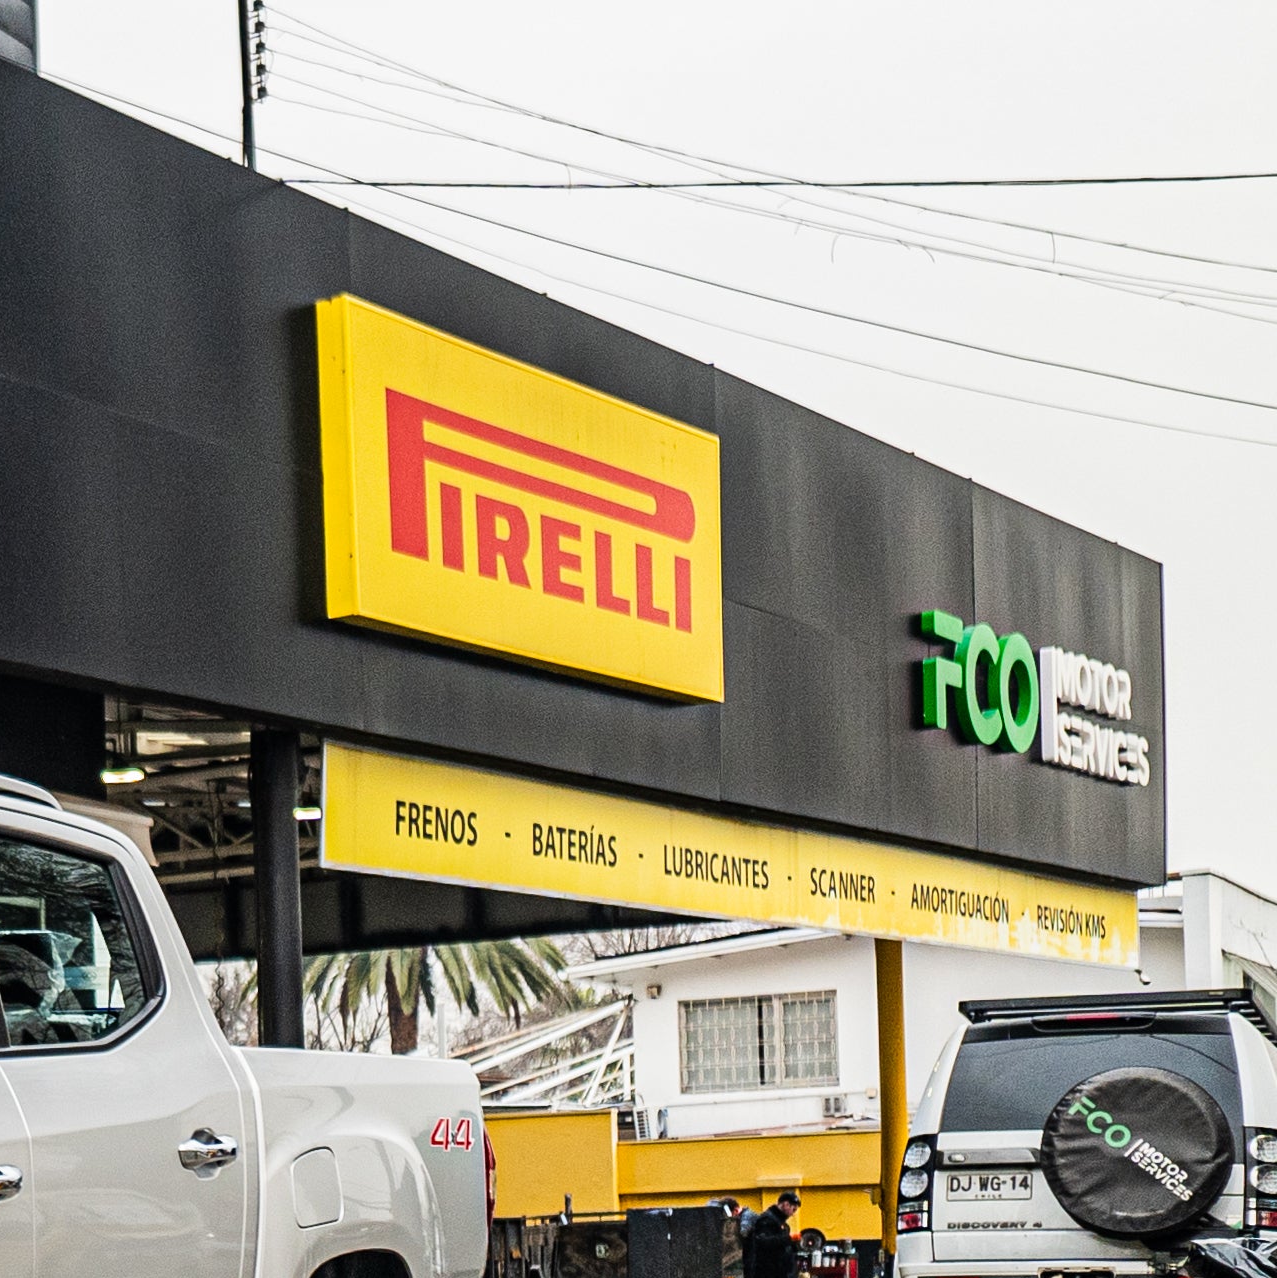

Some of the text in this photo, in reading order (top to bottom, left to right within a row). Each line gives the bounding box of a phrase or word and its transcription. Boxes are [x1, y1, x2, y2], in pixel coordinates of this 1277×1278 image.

[386, 387, 696, 633] PIRELLI
[921, 609, 1039, 754] FCO
[1054, 648, 1132, 721] MOTOR
[1056, 713, 1150, 787] SERVICES
[395, 799, 1106, 939] FRENOS BATERÍAS LUBRICANTES SCANNER AMORTIGUACIÓN REVISIÓN KMS
[1068, 1096, 1131, 1149] FCO
[1131, 1151, 1193, 1201] SERVICES
[1139, 1142, 1188, 1182] MOTOR
